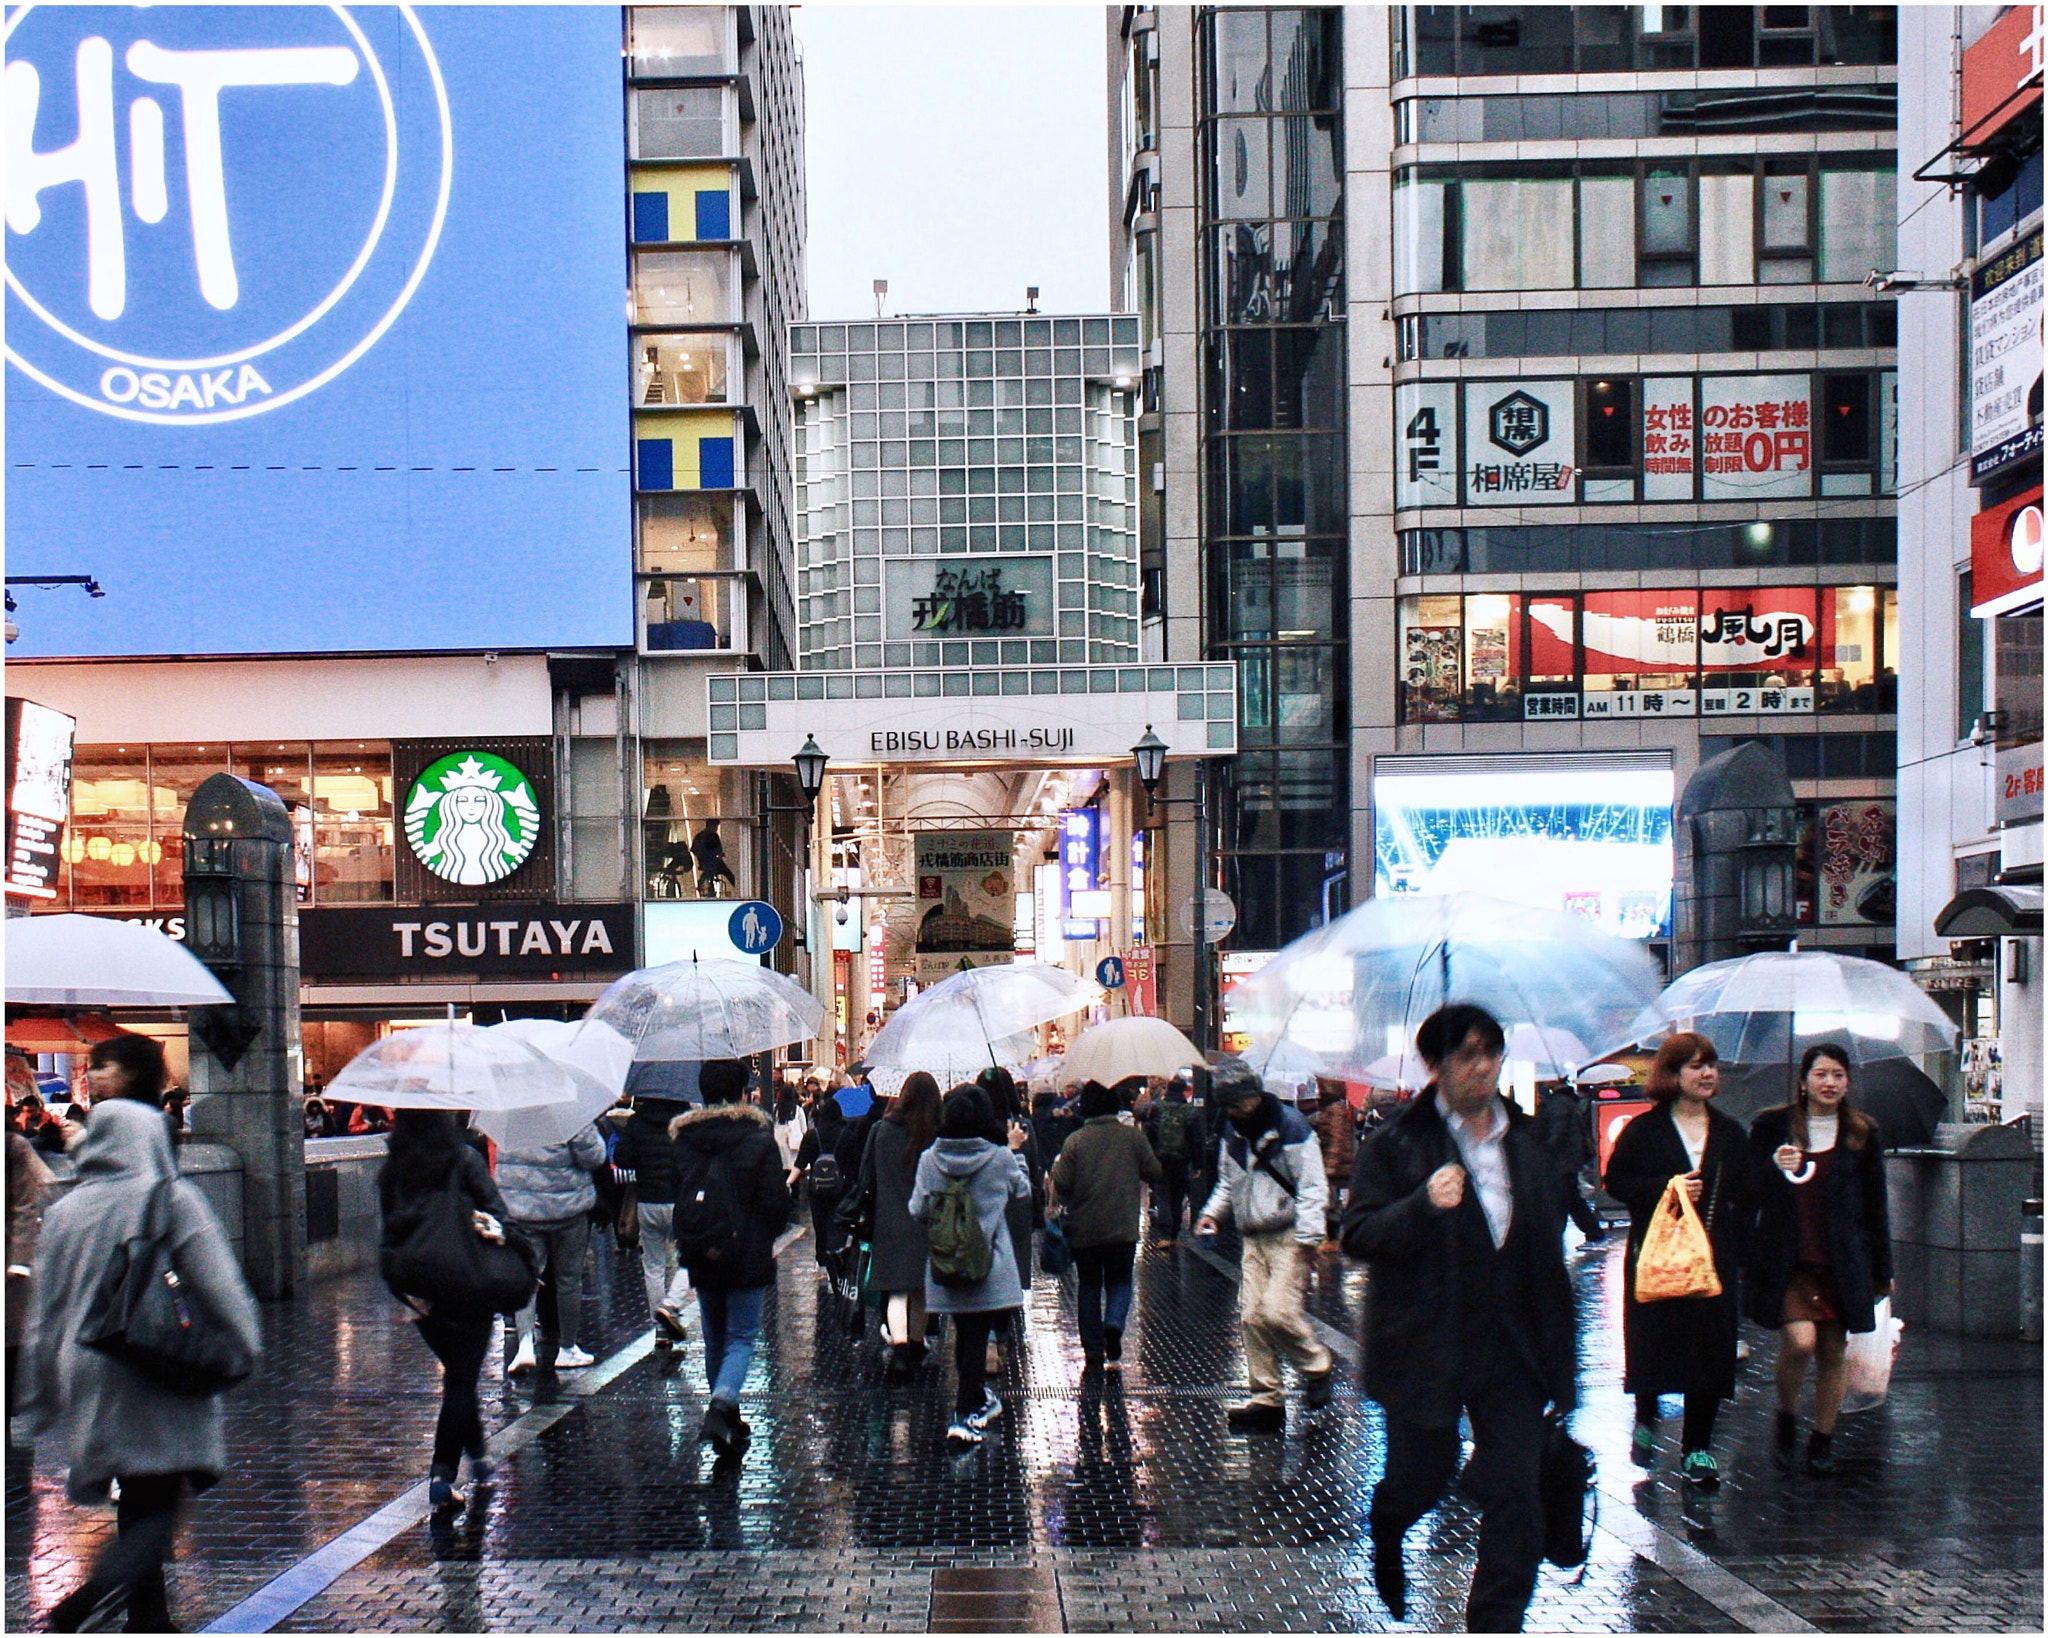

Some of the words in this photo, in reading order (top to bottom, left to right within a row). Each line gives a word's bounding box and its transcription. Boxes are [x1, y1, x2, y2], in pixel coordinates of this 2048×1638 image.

[101, 365, 271, 410] OSAKA
[1471, 462, 1562, 493] 相席屋
[936, 568, 1002, 591] なんば
[1702, 603, 1804, 657] 風月
[1587, 702, 1608, 713] AM
[871, 731, 940, 751] EBISU
[392, 920, 613, 957] TSUTAYA
